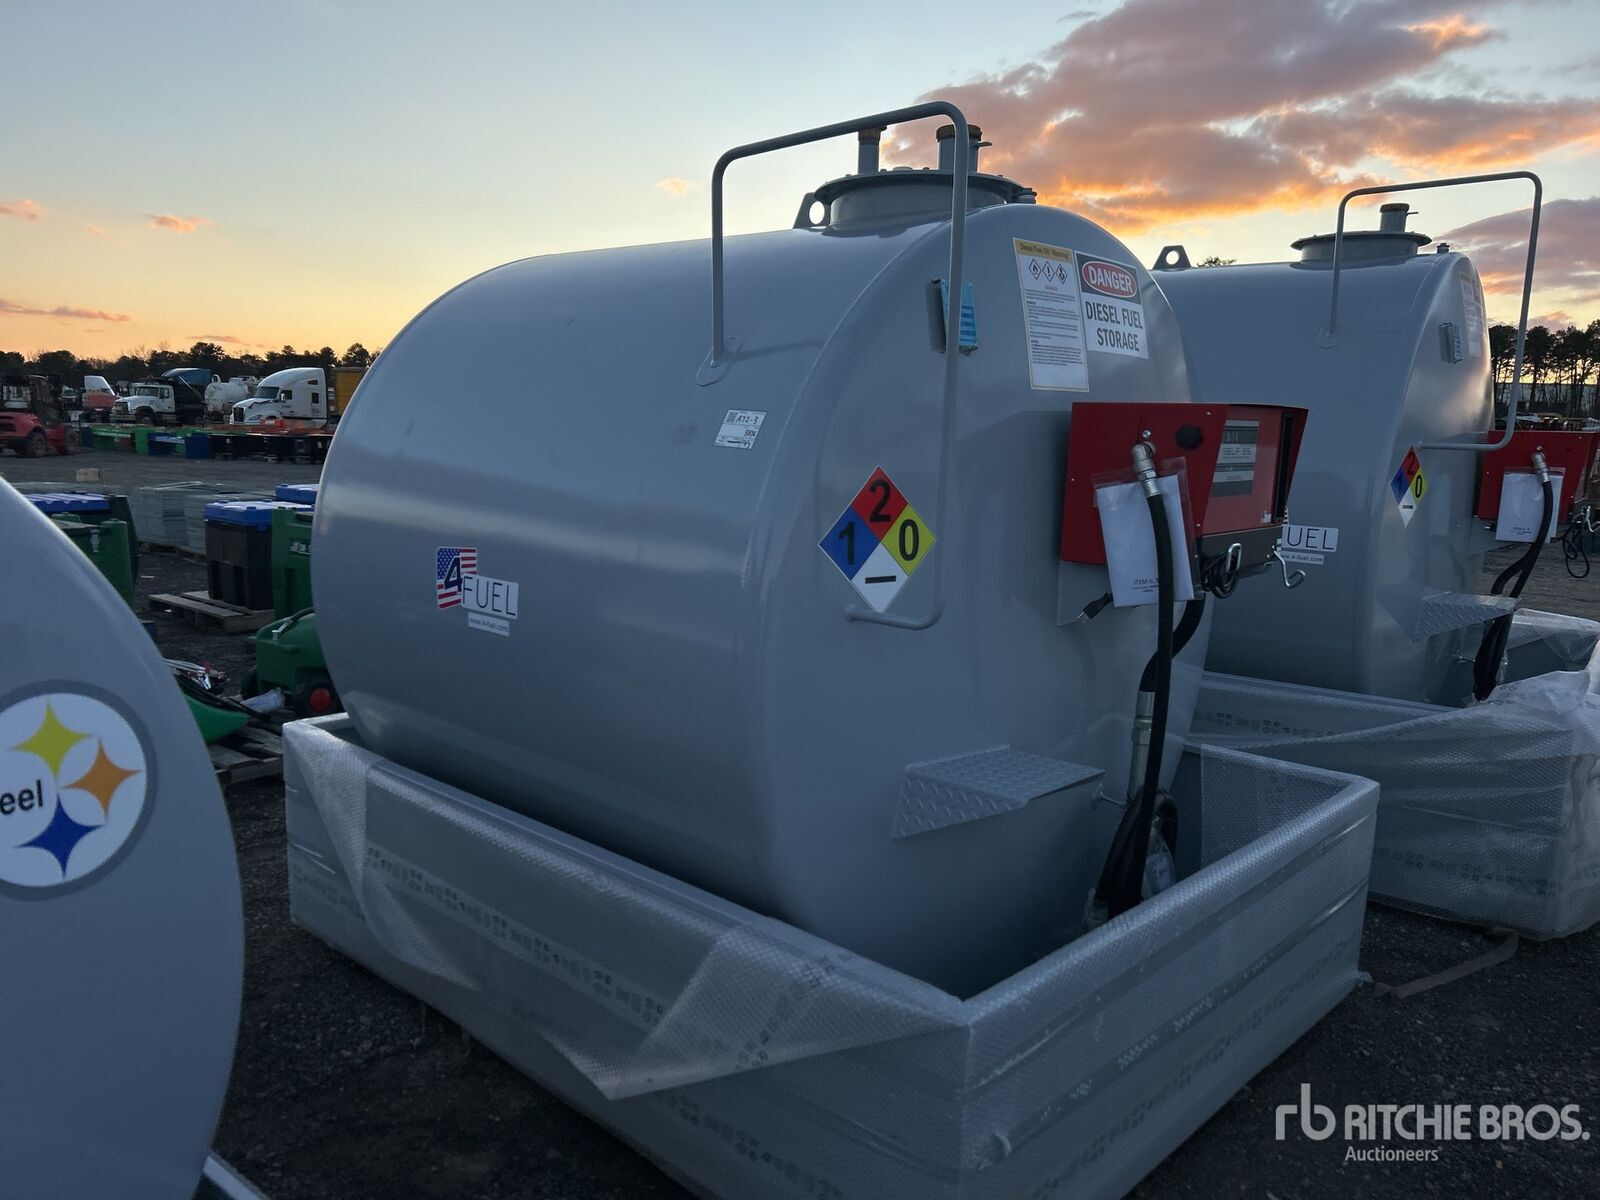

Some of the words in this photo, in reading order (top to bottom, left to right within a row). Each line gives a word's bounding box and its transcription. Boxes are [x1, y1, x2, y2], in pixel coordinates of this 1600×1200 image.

[1088, 266, 1133, 293] DANGER
[1085, 301, 1120, 325] DIESEL
[1122, 308, 1143, 330] FUEL
[1097, 328, 1140, 351] STORAGE
[869, 479, 891, 522] 2
[1415, 474, 1423, 498] 0
[838, 520, 855, 565] 1
[899, 518, 919, 561] 0
[1287, 526, 1335, 550] UEL
[443, 556, 463, 592] 4
[463, 576, 516, 616] FUEL
[0, 779, 44, 816] eel
